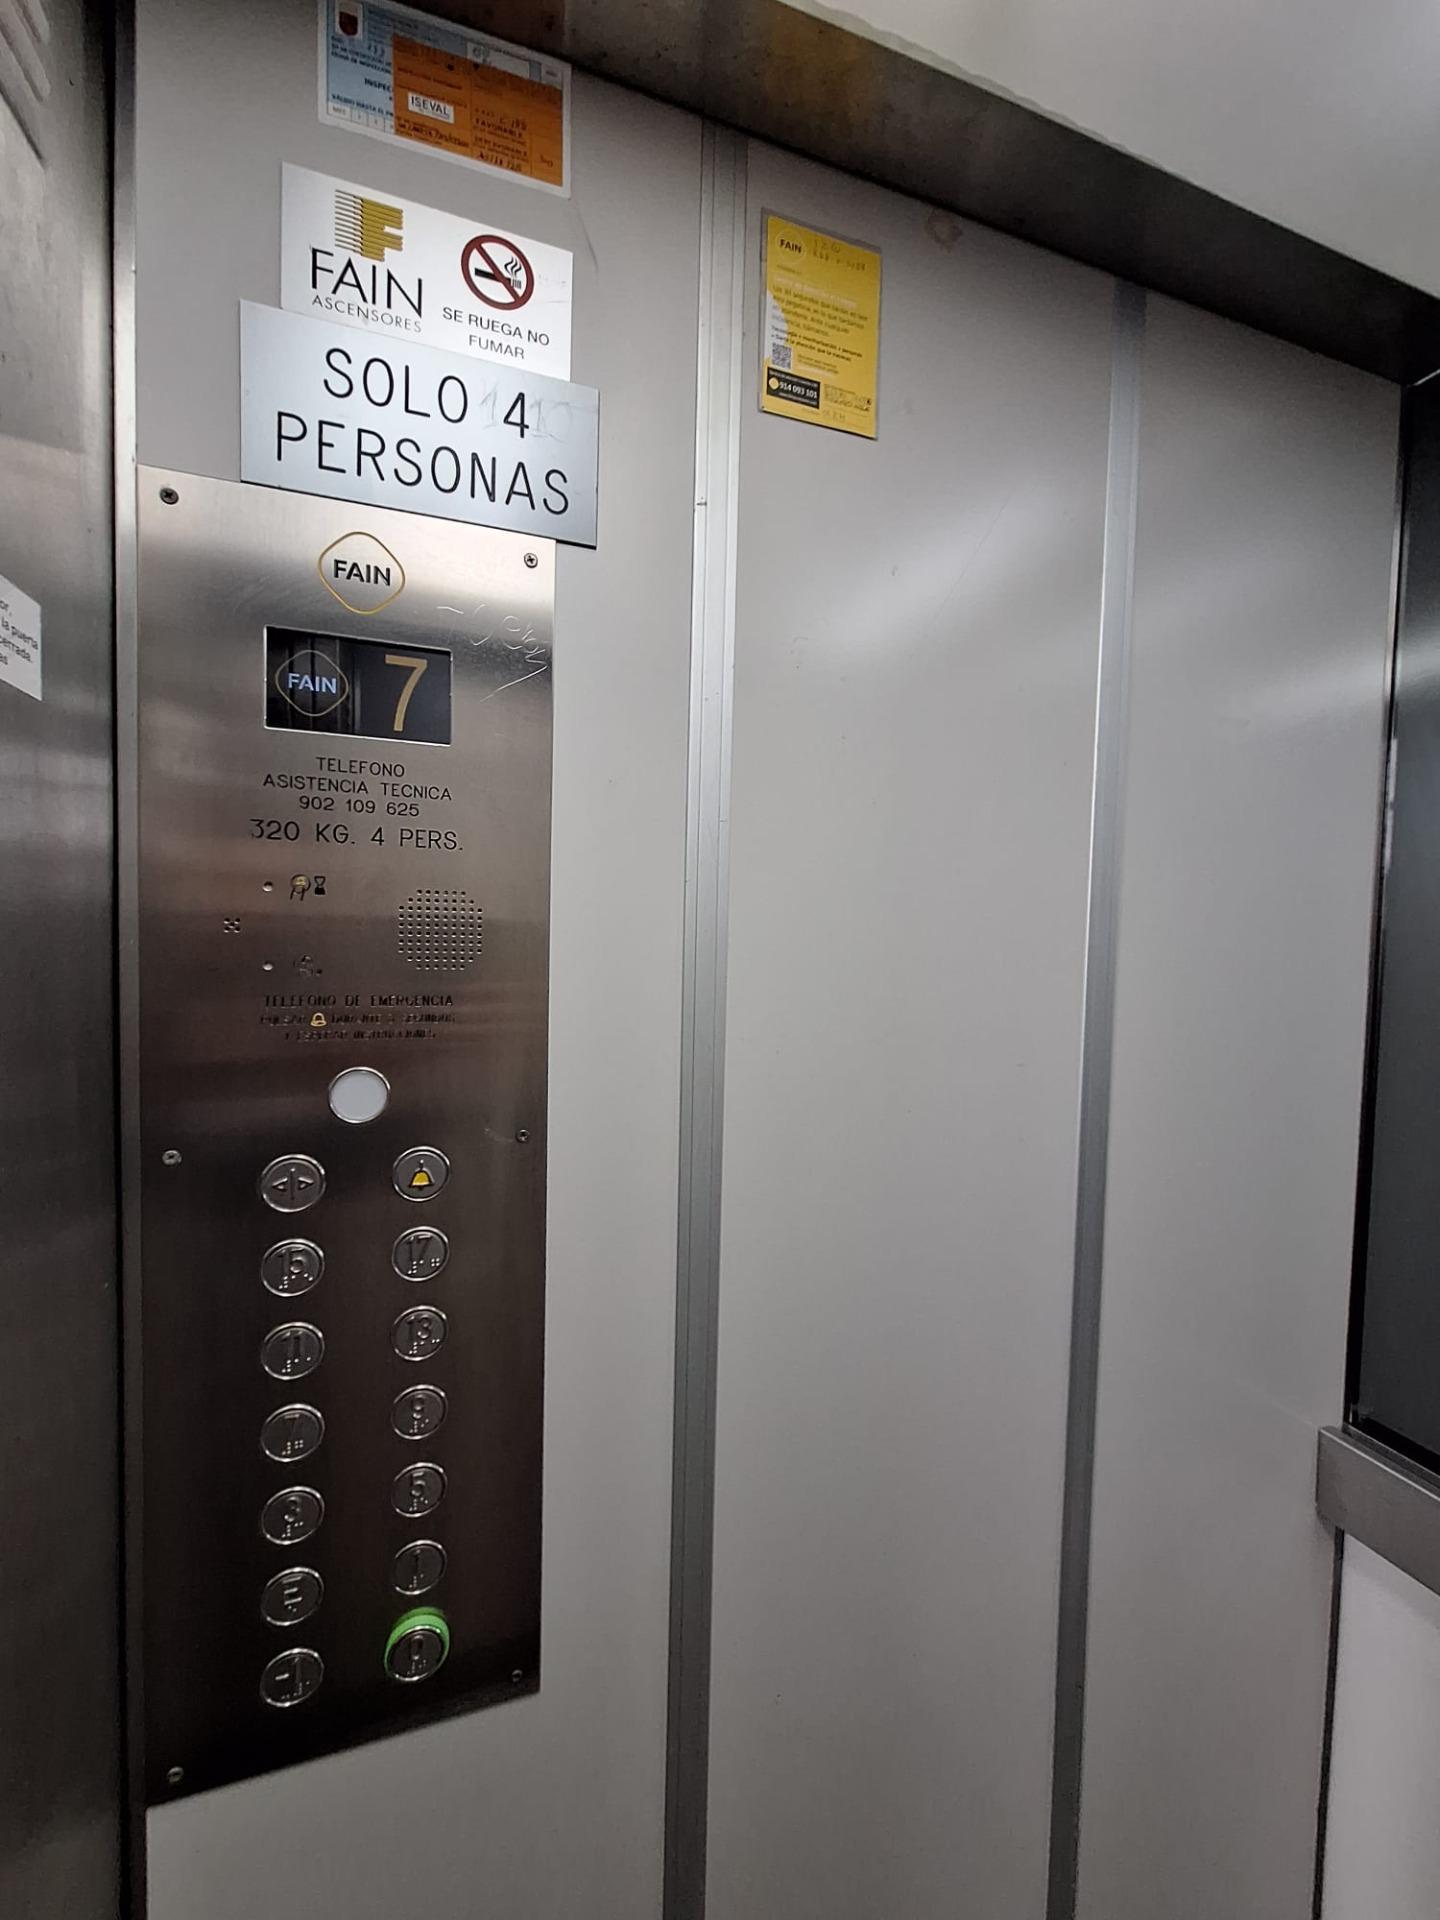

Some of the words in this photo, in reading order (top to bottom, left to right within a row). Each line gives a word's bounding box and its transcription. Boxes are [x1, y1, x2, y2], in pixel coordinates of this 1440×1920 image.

[411, 95, 450, 116] ISEVAL
[779, 238, 802, 254] FAIN
[310, 246, 423, 319] FAIN
[312, 294, 422, 334] ASCENSORES
[442, 306, 464, 325] SE
[467, 311, 523, 340] RUEGA
[527, 329, 550, 347] NO
[469, 334, 525, 360] FUMAR
[323, 347, 468, 424] SOLO
[503, 392, 530, 439] 4
[276, 411, 569, 516] PERSONAS
[333, 558, 391, 586] FAIN
[287, 672, 337, 694] FAIN
[385, 654, 428, 732] 7
[316, 757, 405, 778] TELEFONO
[263, 774, 369, 795] ASISTENCIA
[380, 782, 452, 801] TECNICA
[299, 796, 335, 812] 902
[346, 799, 376, 814] 109
[386, 802, 420, 817] 625
[250, 818, 300, 841] 320
[316, 823, 355, 845] KG.
[370, 827, 385, 846] 4
[400, 828, 464, 851] PERS.
[265, 995, 336, 1007] TELEFONO
[345, 995, 360, 1007] DE
[371, 995, 453, 1007] EMERGENCIA
[277, 1246, 305, 1273] 15
[405, 1233, 432, 1262] 17
[405, 1313, 432, 1340] 13
[411, 1471, 426, 1497] 5
